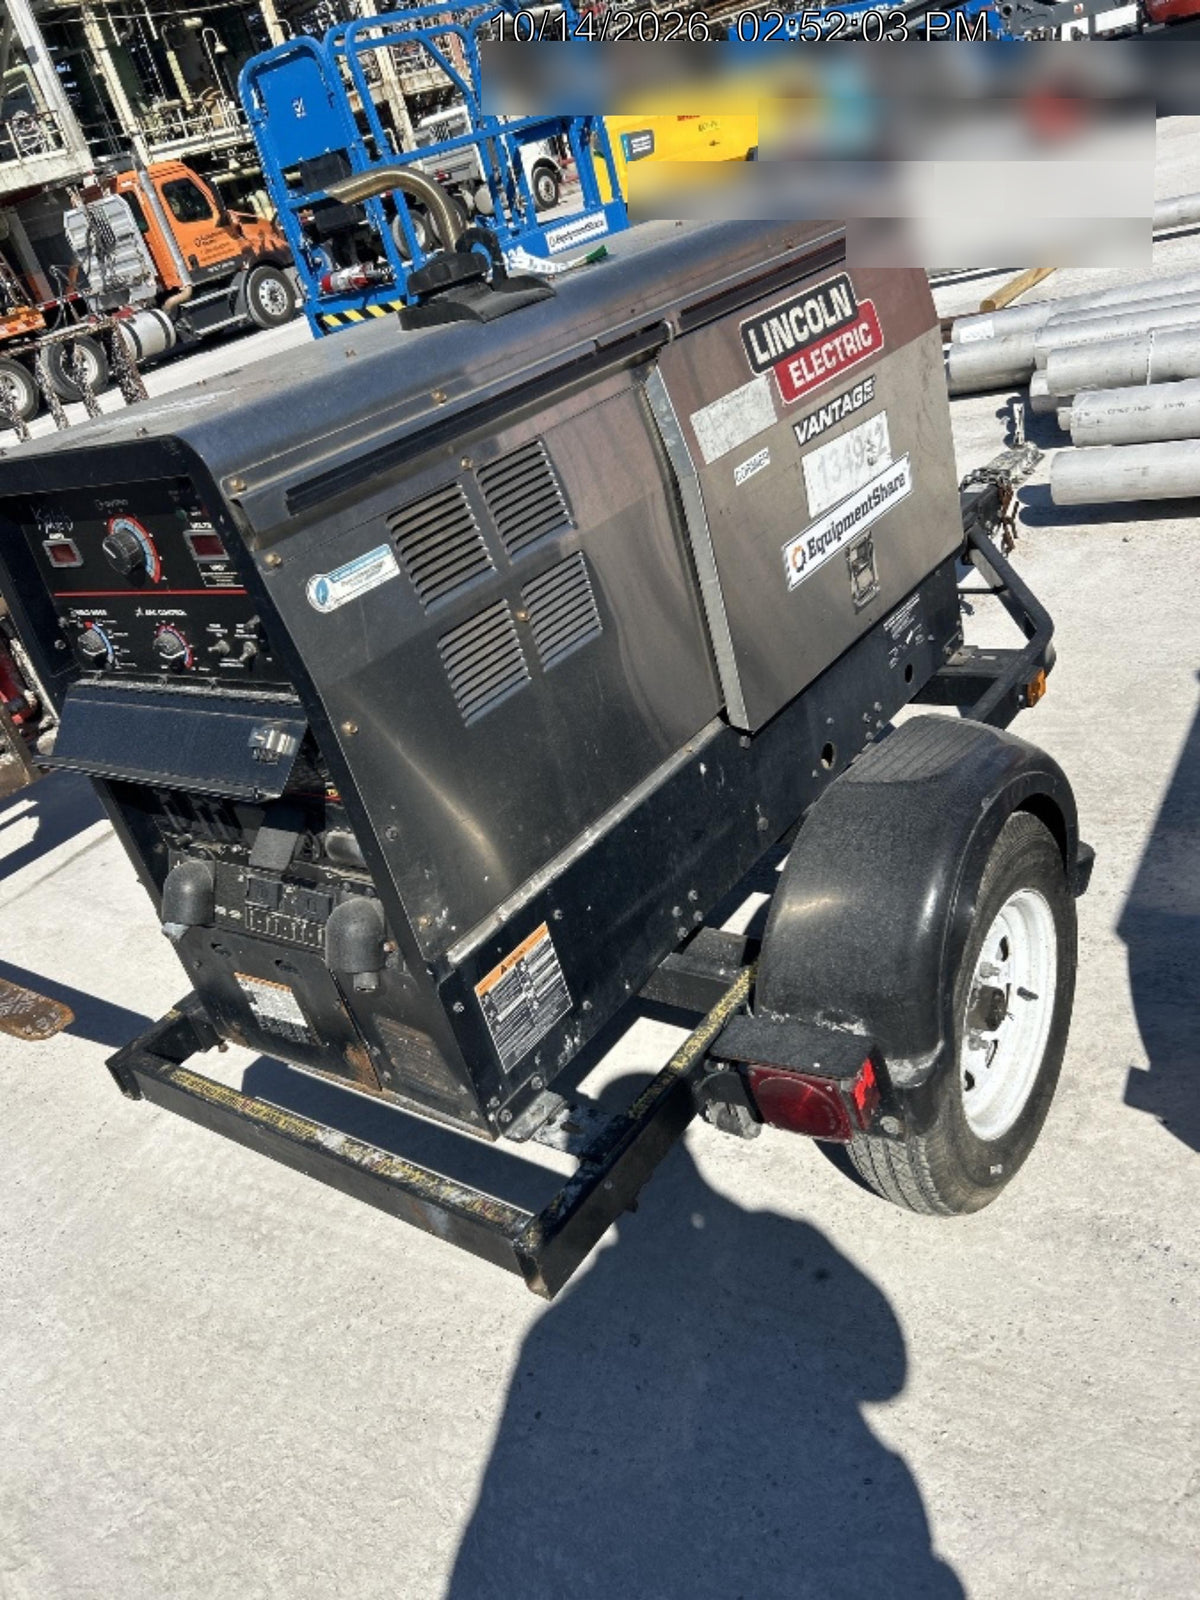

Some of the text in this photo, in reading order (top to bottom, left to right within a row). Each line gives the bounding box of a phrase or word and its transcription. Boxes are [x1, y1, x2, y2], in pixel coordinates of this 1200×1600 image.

[747, 282, 853, 366] LINCOLN
[787, 322, 874, 392] ELECTRIC
[794, 378, 875, 446] VANTAGE
[806, 471, 906, 561] EquipmentShare
